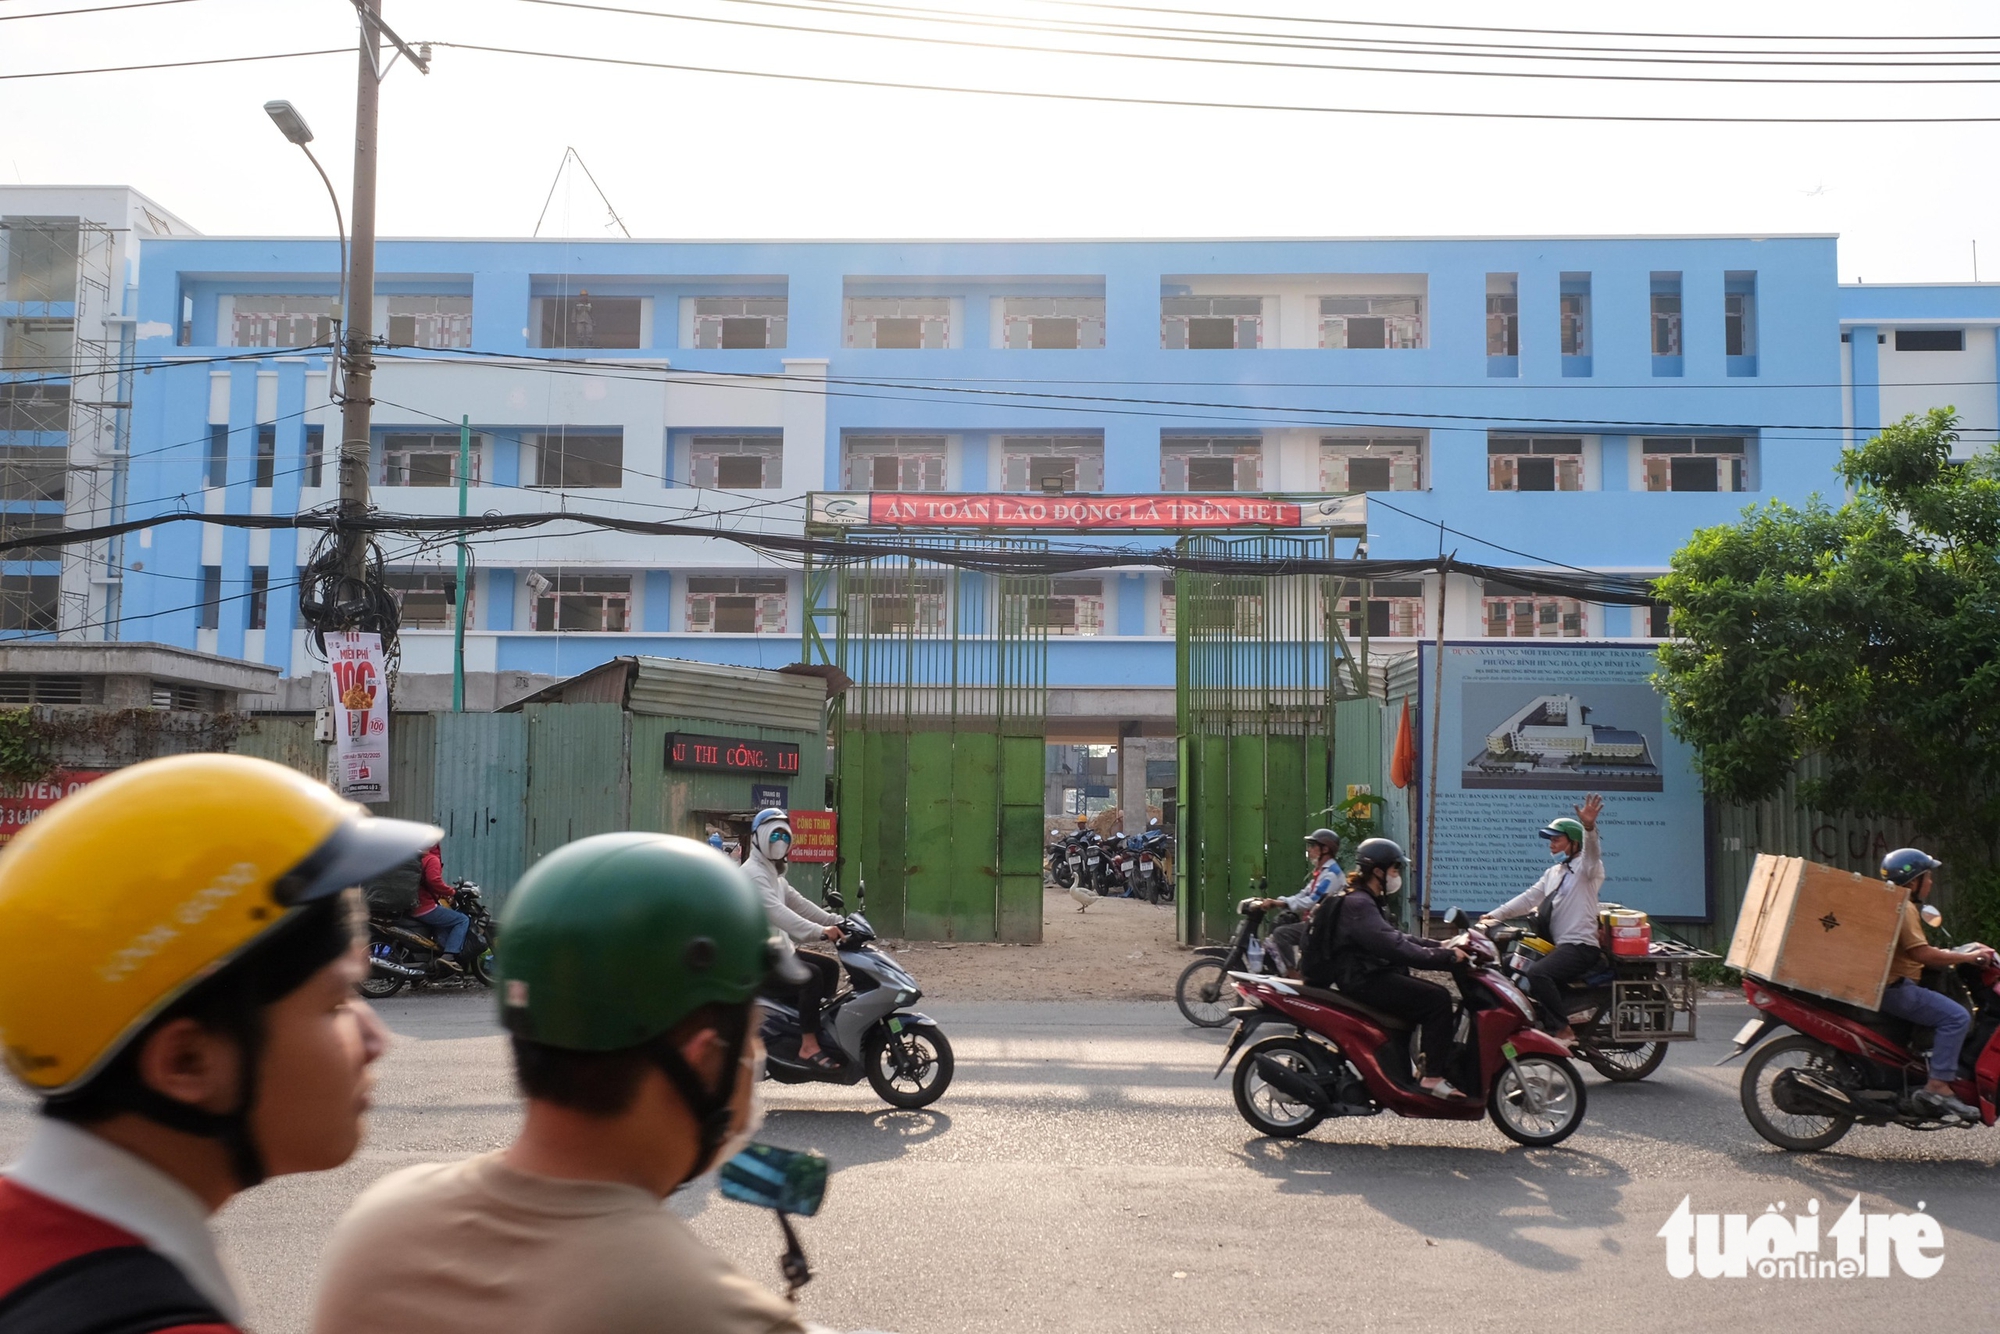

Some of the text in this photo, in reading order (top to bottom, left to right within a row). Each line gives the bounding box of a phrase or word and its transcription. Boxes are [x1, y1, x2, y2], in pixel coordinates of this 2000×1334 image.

[885, 502, 919, 519] AN
[924, 498, 990, 520] TOÀN
[997, 503, 1047, 521] LAO
[1052, 502, 1121, 525] ĐỘNG
[1128, 500, 1163, 521] LÀ
[1167, 500, 1234, 521] TRÊN
[356, 647, 368, 660] PHÍ
[370, 721, 384, 731] 100
[694, 745, 718, 764] THI
[727, 744, 768, 768] CÔNG:
[7, 809, 15, 824] 3
[797, 816, 831, 830] CÔNG TRÌNH
[808, 834, 818, 845] THI
[818, 832, 834, 846] CÔNG
